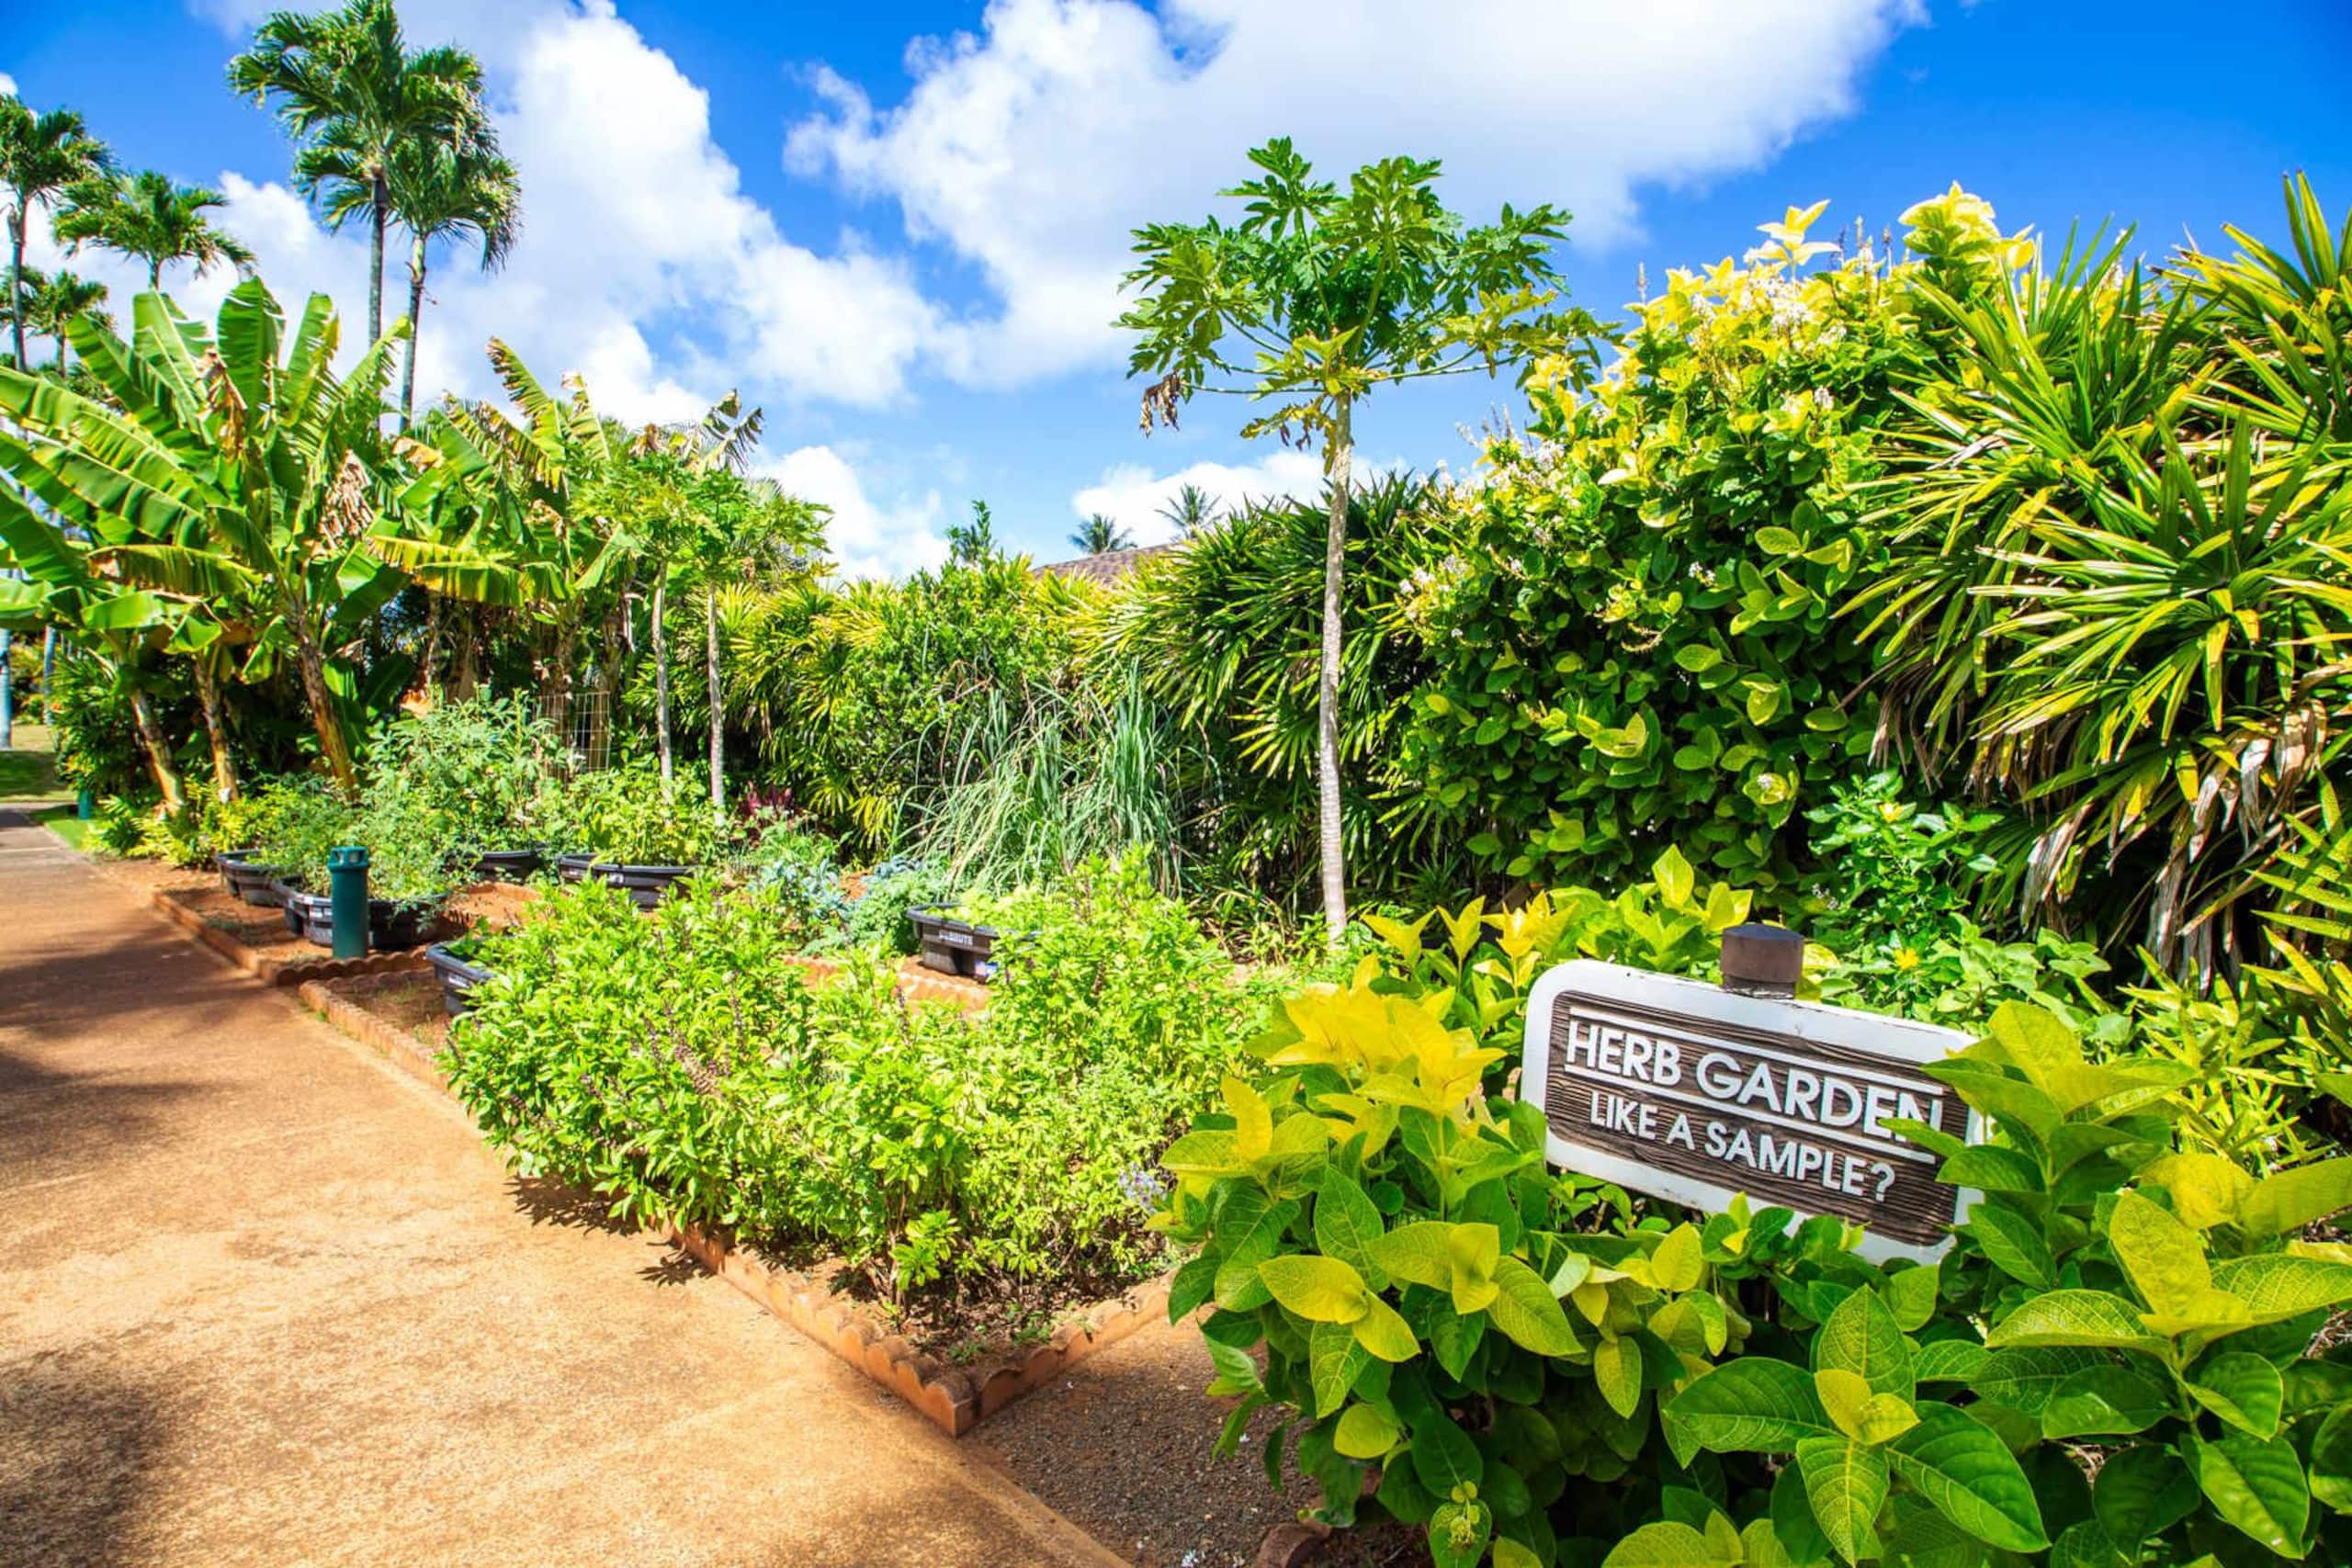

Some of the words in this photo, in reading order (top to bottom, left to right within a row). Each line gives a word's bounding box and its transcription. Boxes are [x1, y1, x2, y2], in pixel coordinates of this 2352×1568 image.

[1566, 1020, 1681, 1087] HERB
[1696, 1053, 1941, 1142] GARDEN
[1590, 1093, 1658, 1140] LIKE
[1667, 1113, 1696, 1150] A
[1705, 1122, 1895, 1201] SAMPLE?
